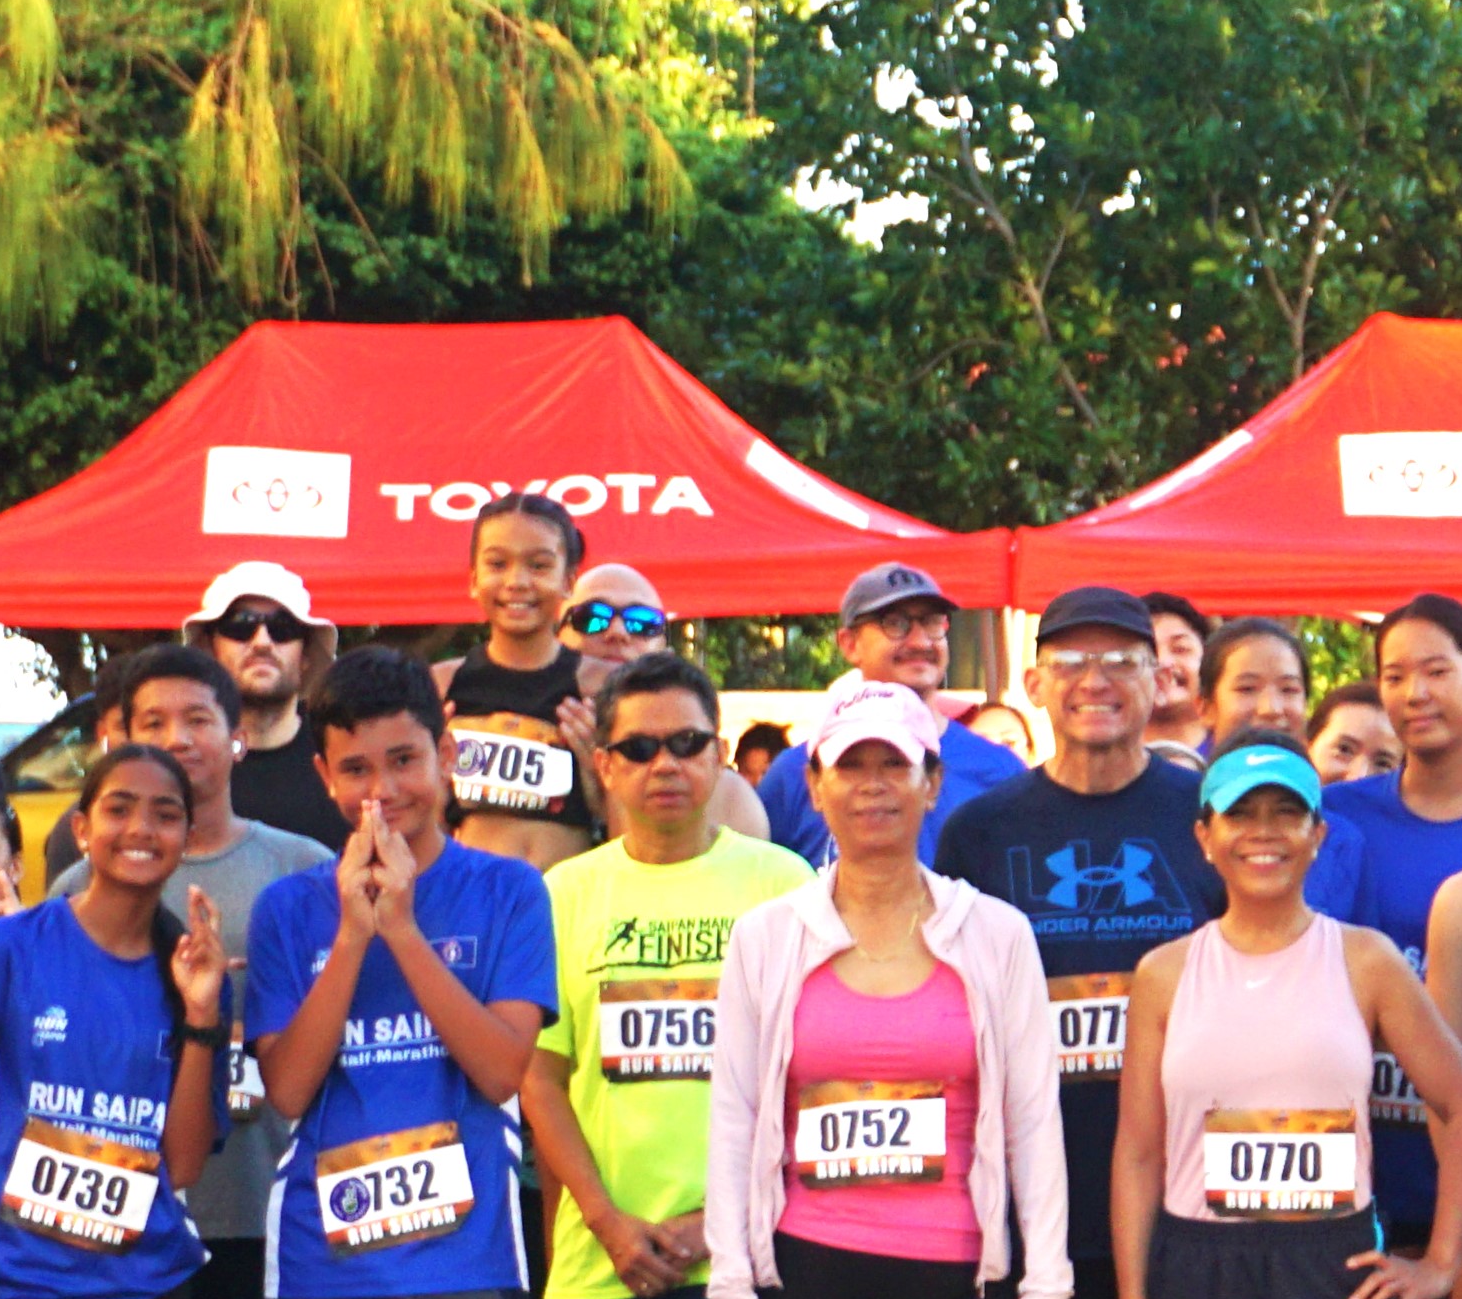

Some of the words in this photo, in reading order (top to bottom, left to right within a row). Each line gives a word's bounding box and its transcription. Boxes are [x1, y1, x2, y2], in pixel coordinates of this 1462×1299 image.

[380, 473, 714, 521] TOYOTA
[481, 741, 547, 787] 705
[649, 919, 695, 932] SAIPAN
[1037, 916, 1089, 934] NDER
[1094, 914, 1193, 932] ARMOUR
[620, 1007, 716, 1049] 0756
[1059, 1004, 1127, 1048] 077
[619, 1056, 655, 1075] RUN
[28, 1080, 85, 1116] RUN
[820, 1106, 911, 1152] 0752
[816, 1159, 851, 1179] RUN
[857, 1155, 924, 1176] SAIPAN
[1230, 1140, 1323, 1182] 0770
[31, 1155, 130, 1218] 0739
[364, 1159, 440, 1211] 732
[1225, 1190, 1262, 1210] RUN
[1267, 1190, 1335, 1210] SAIPAN
[19, 1201, 57, 1228] RUN
[60, 1211, 125, 1246] SAIPAN
[346, 1220, 385, 1247] RUN
[388, 1204, 457, 1236] SAIPAN
